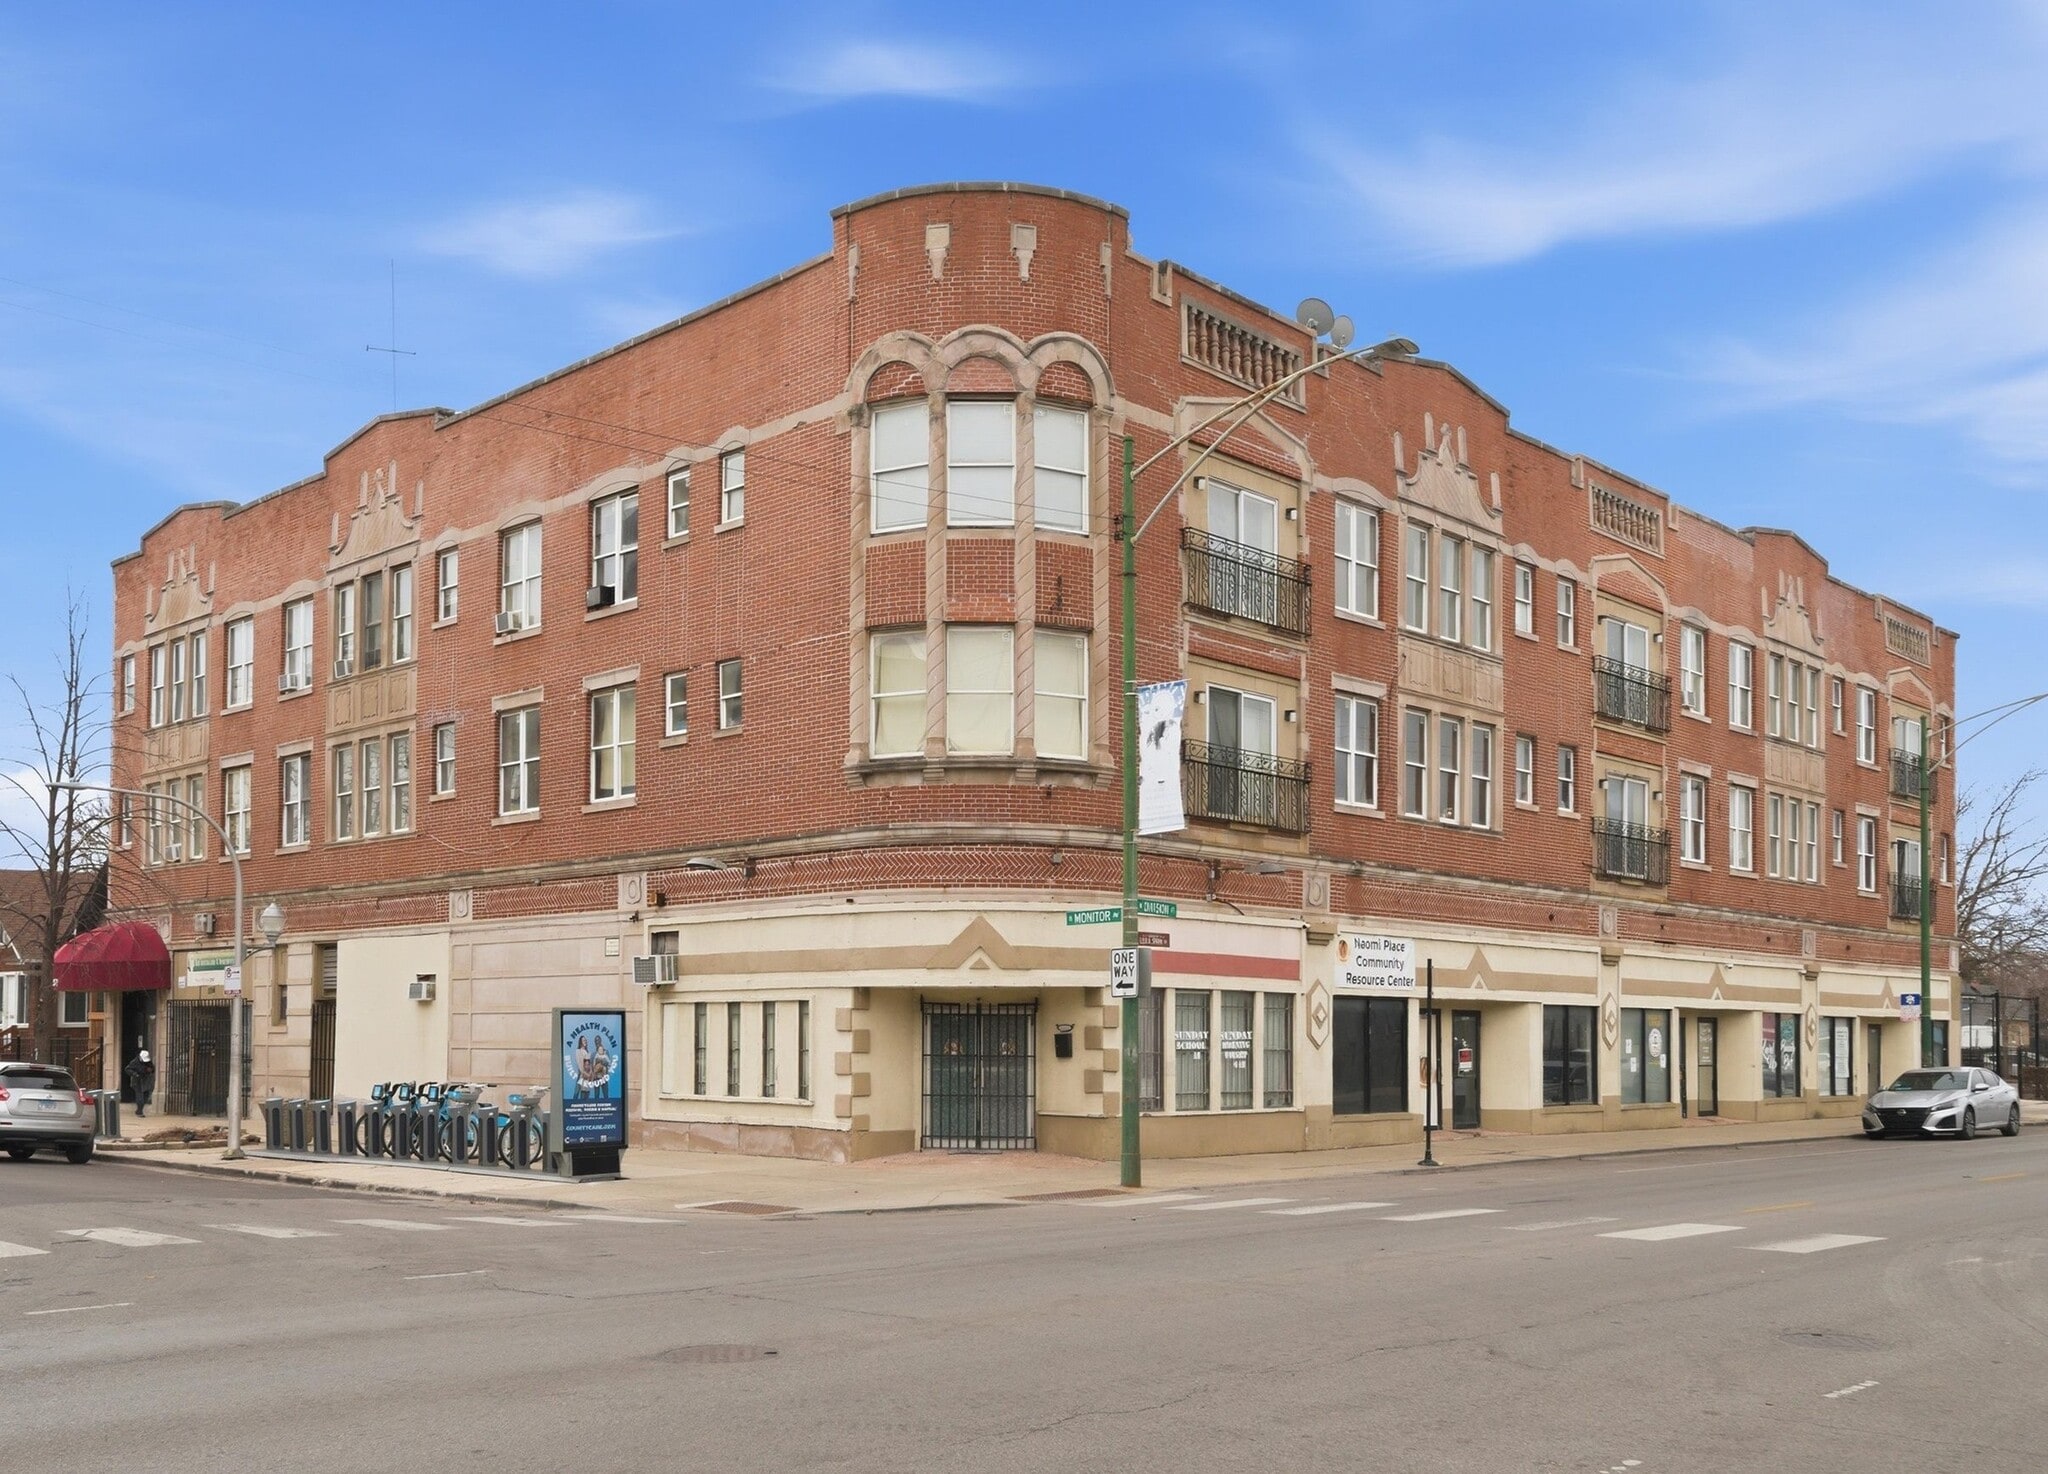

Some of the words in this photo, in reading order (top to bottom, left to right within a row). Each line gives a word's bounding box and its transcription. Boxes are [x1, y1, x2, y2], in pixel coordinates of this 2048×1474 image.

[1144, 901, 1170, 915] DIVISION
[1074, 910, 1111, 923] MONITOR
[1354, 937, 1381, 950] Naomi
[1383, 939, 1405, 952] Place
[1113, 952, 1134, 964] ONE
[1356, 955, 1405, 971] Community
[1113, 965, 1135, 978] WAY
[1346, 972, 1385, 986] Resource
[1387, 975, 1414, 987] Center
[566, 1040, 573, 1048] A
[570, 1022, 600, 1040] HEALTH
[601, 1026, 617, 1049] PLAN
[1174, 1030, 1209, 1040] SUNDAY
[1176, 1041, 1207, 1050] SCHOOL
[577, 1074, 610, 1088] AROUND
